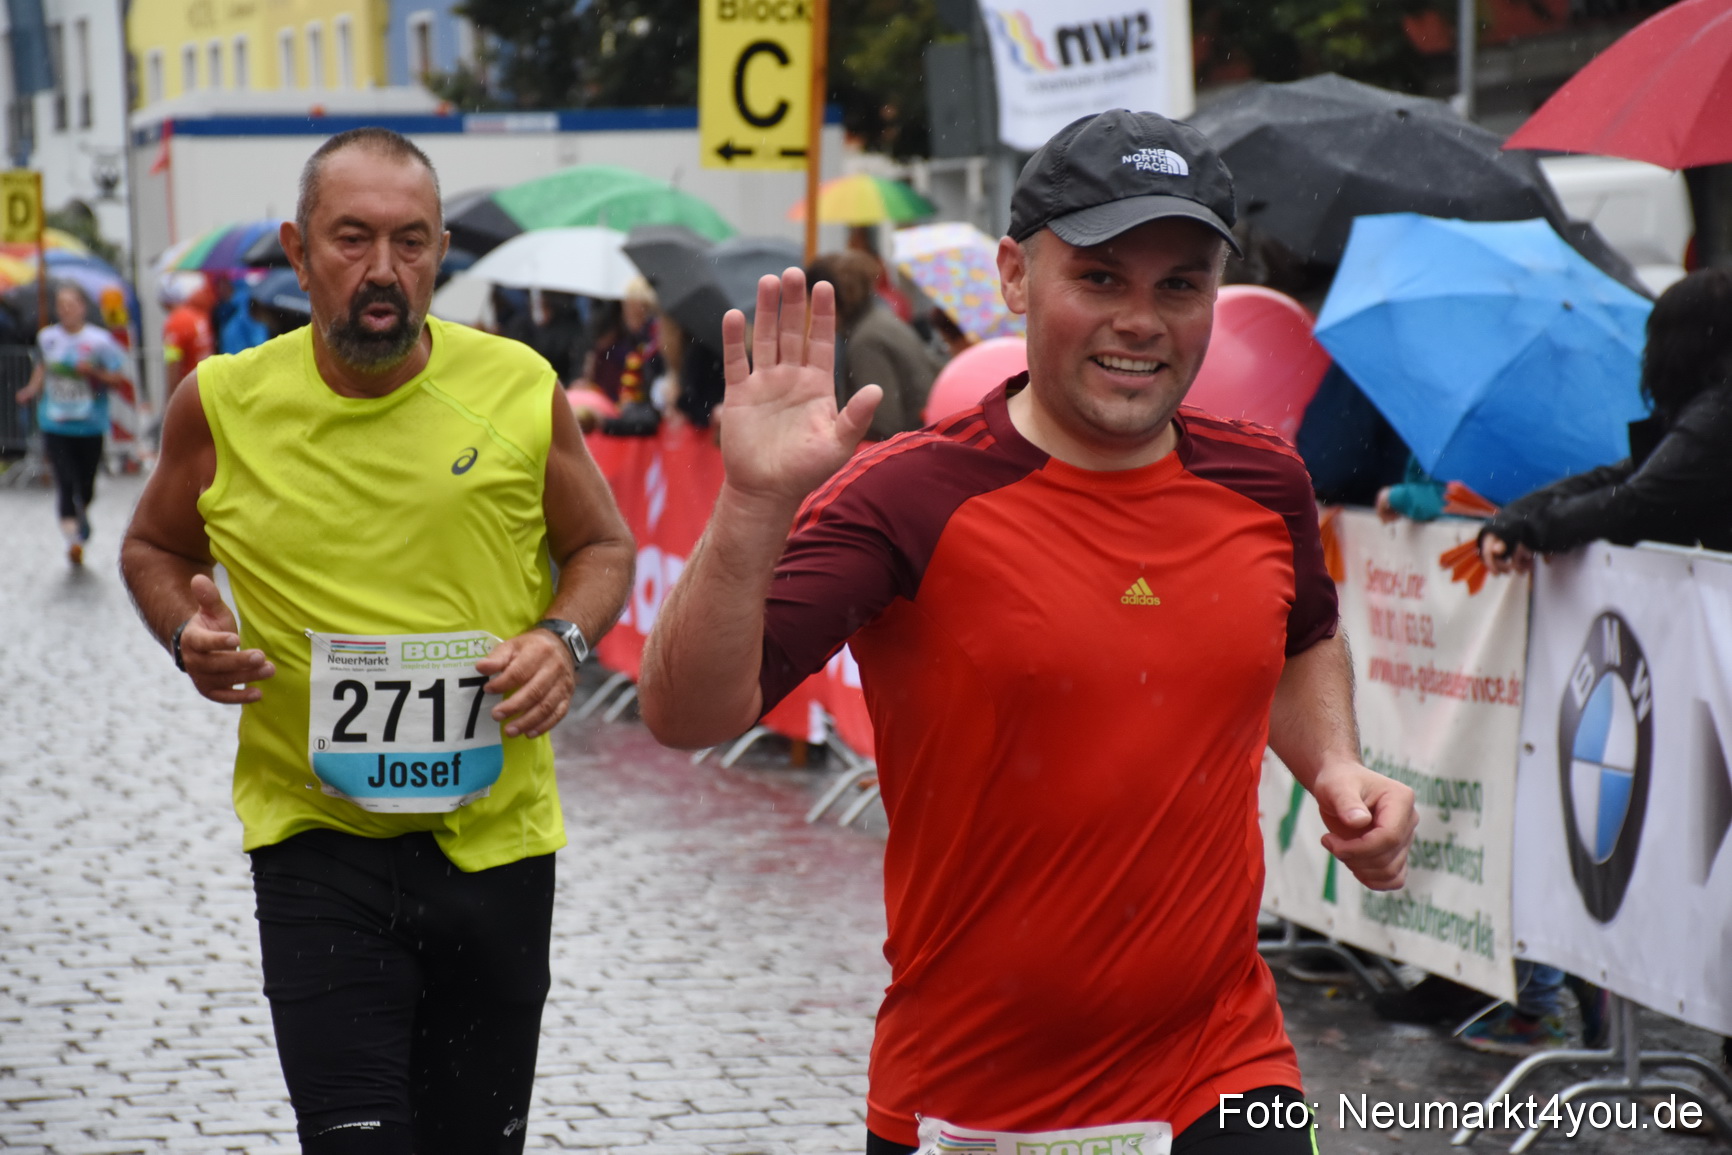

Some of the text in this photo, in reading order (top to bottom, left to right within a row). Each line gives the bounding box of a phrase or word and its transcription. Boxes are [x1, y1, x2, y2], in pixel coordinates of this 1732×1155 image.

[732, 39, 791, 129] C
[1121, 154, 1167, 164] NORTH
[1138, 148, 1166, 157] THE
[1135, 161, 1169, 173] FACE
[8, 191, 32, 229] D
[1120, 595, 1161, 606] adidas
[401, 636, 488, 662] BOCK
[327, 654, 390, 667] NeuerMarkt
[1570, 617, 1652, 723] BMW
[332, 676, 491, 743] 2717
[318, 739, 326, 750] D
[367, 753, 463, 788] Josef
